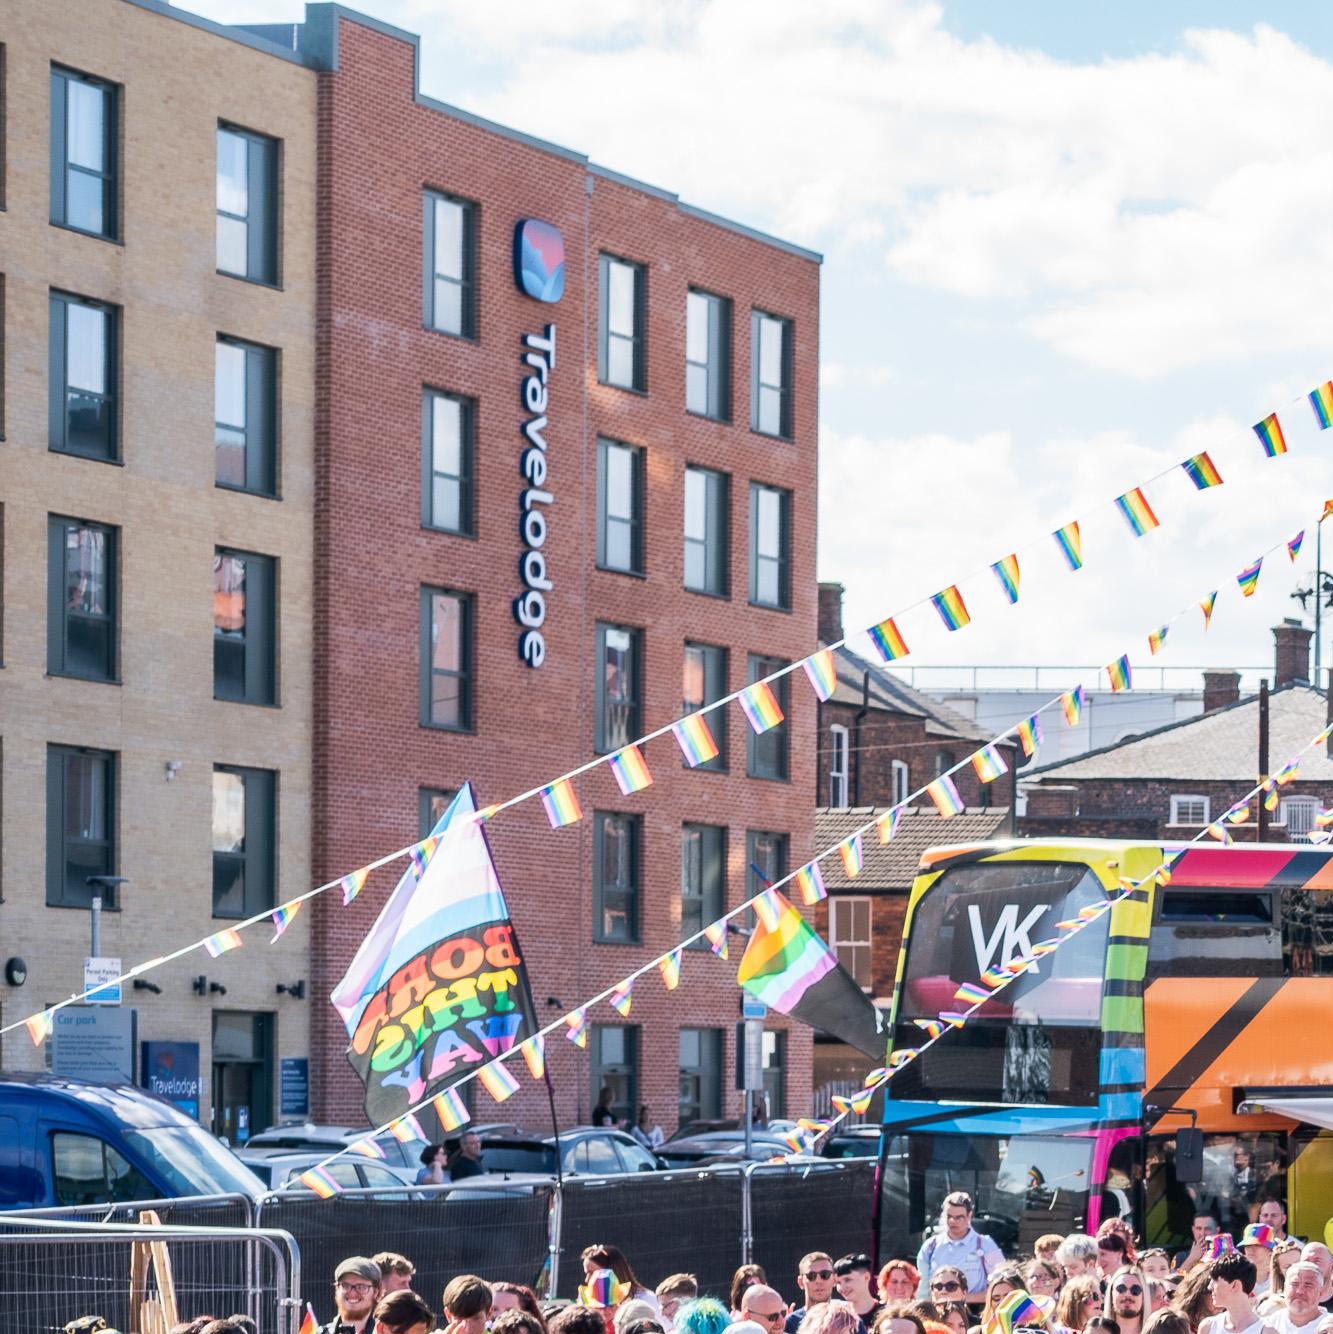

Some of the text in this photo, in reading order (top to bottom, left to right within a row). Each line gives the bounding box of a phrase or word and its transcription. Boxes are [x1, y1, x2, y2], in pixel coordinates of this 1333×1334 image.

[518, 323, 557, 669] Travelodge
[967, 904, 1048, 975] VK
[57, 1014, 97, 1026] Car park
[151, 1075, 198, 1097] Travelodge
